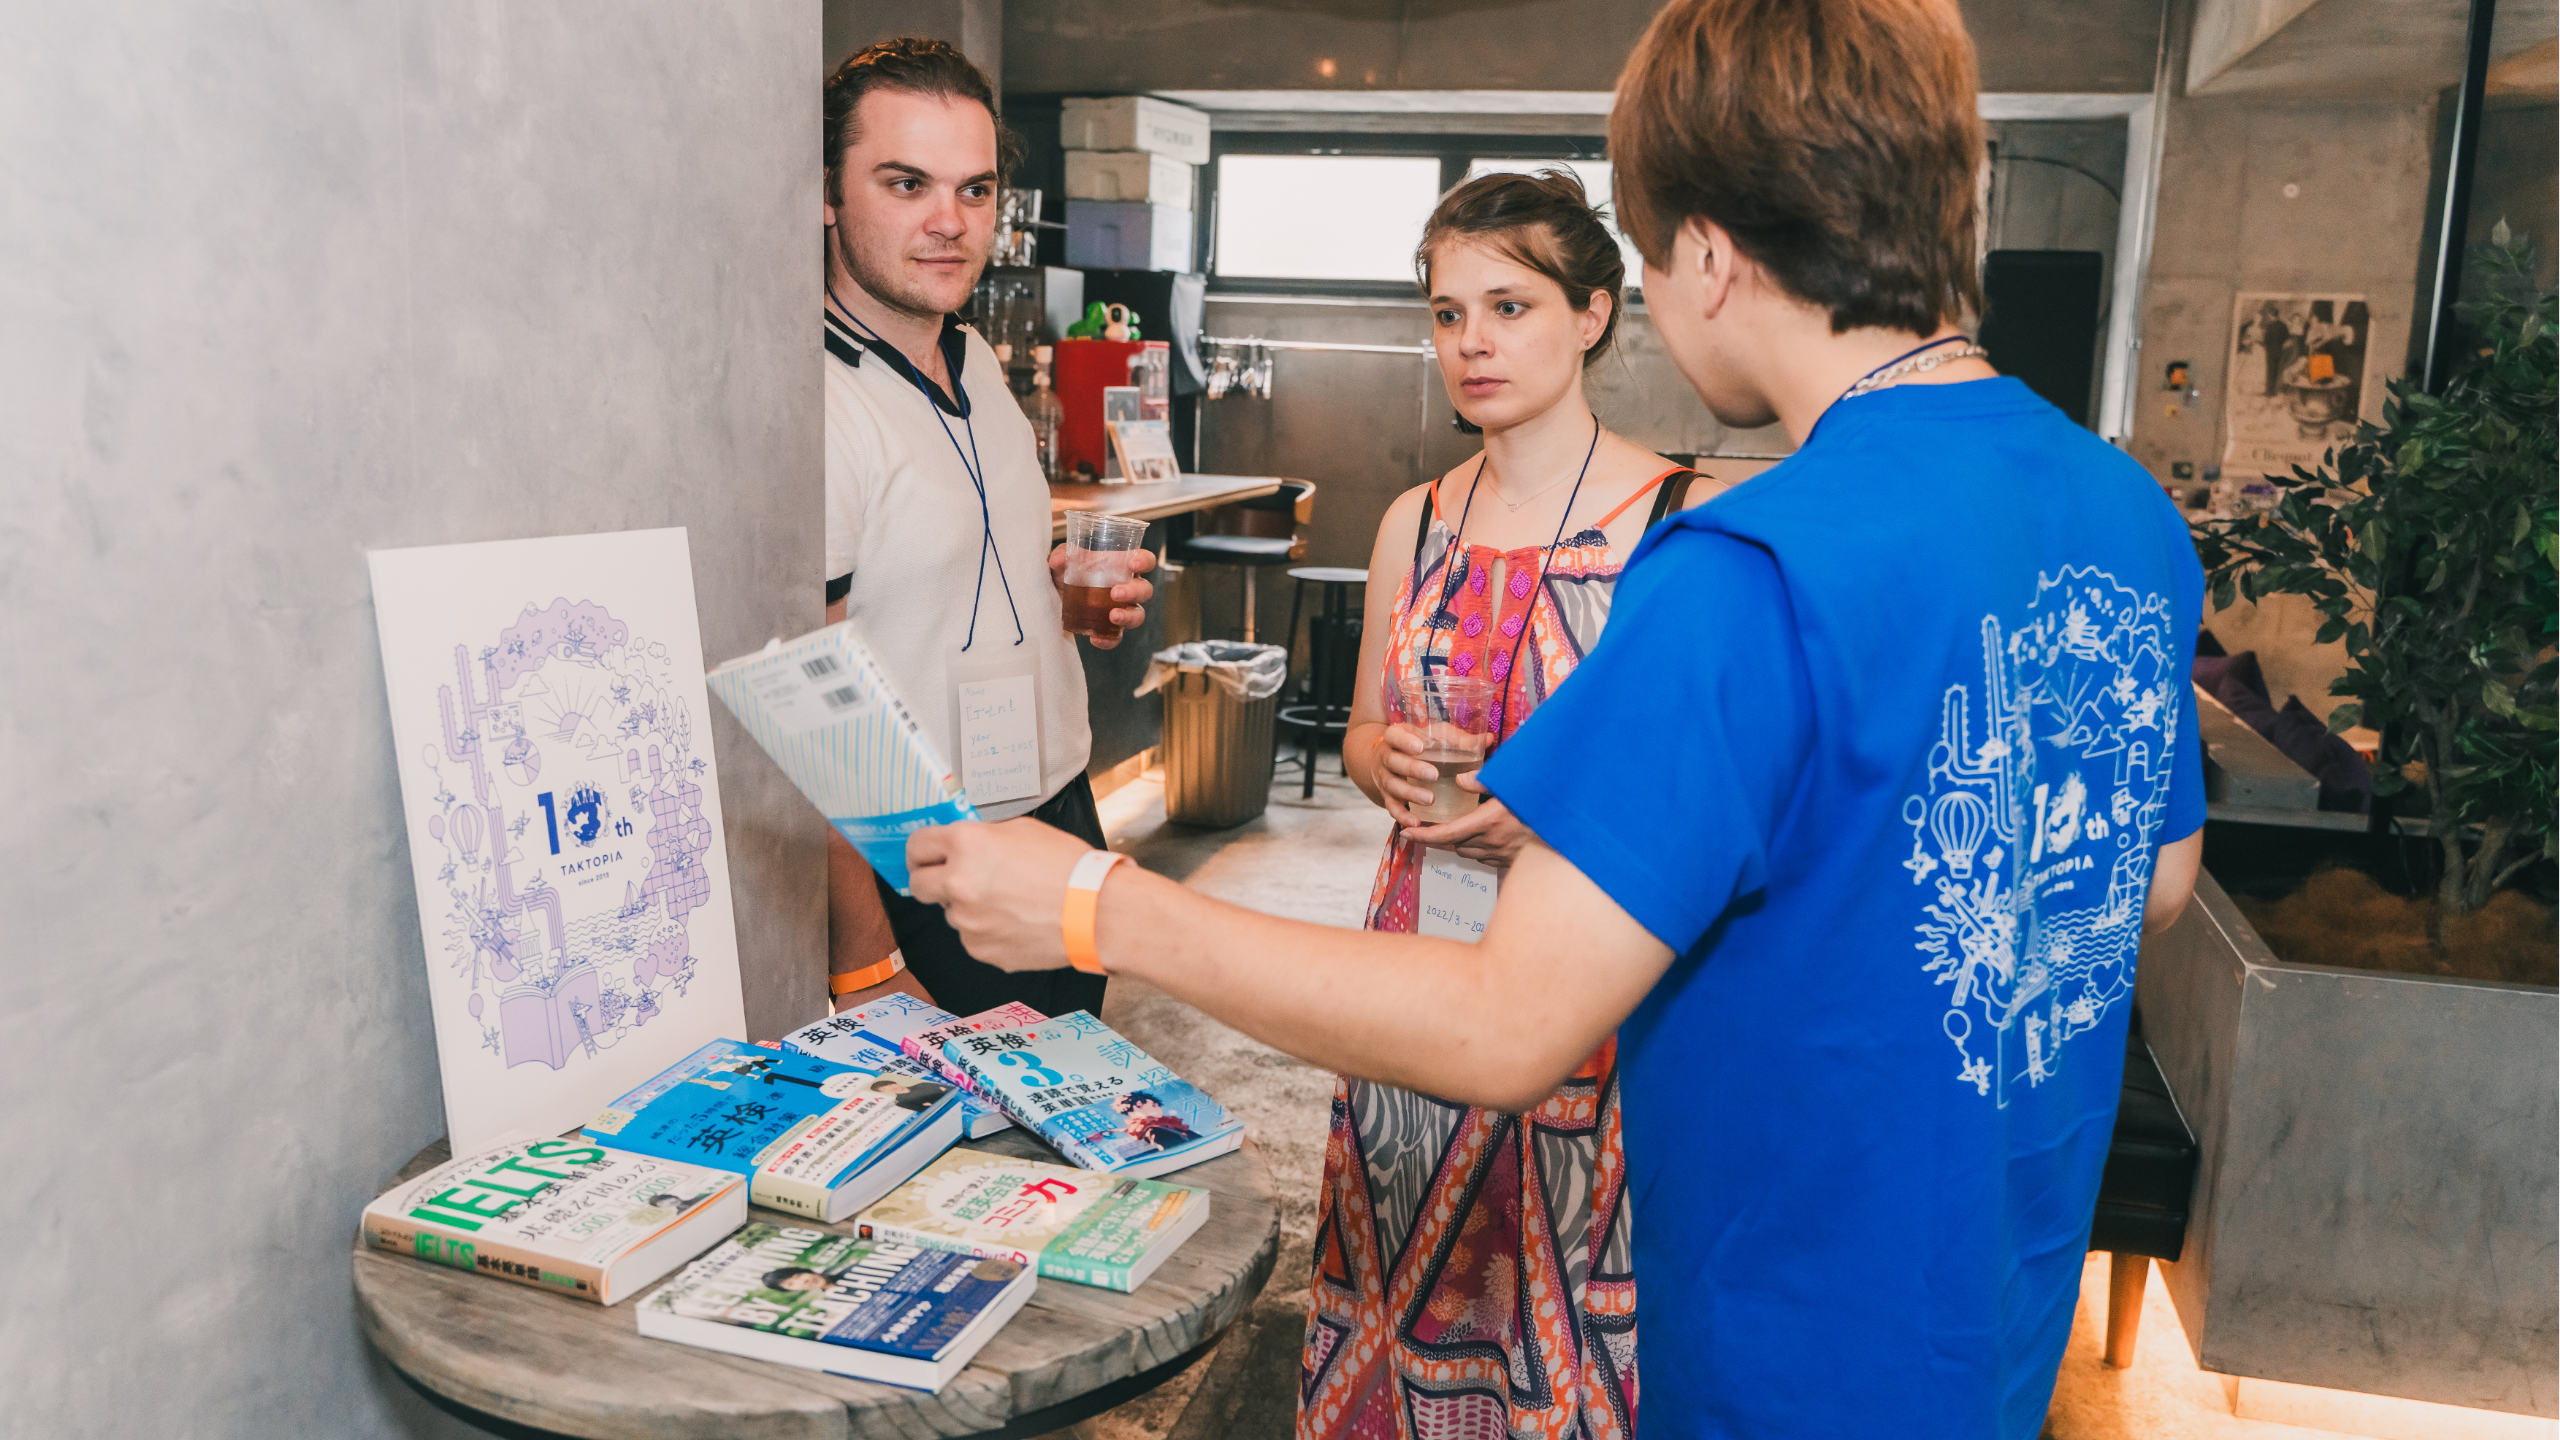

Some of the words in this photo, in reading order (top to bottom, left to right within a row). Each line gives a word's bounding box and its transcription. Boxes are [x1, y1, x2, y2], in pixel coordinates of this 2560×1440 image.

[560, 850, 623, 876] TAKTOPIA
[1470, 920, 1485, 933] 202
[799, 1014, 865, 1046] 英検
[963, 1032, 1034, 1056] 英検
[1026, 1076, 1124, 1105] 速読で覚える
[1039, 1095, 1095, 1115] 英単語
[686, 1101, 779, 1155] 英検
[732, 1109, 799, 1160] 総合対策
[408, 1140, 606, 1232] IELTS
[951, 1174, 1026, 1221] 超英会話
[414, 1230, 476, 1270] IELTS
[690, 1226, 825, 1319] LEARNING
[777, 1241, 926, 1341] TEACHING
[728, 1296, 792, 1326] BY
